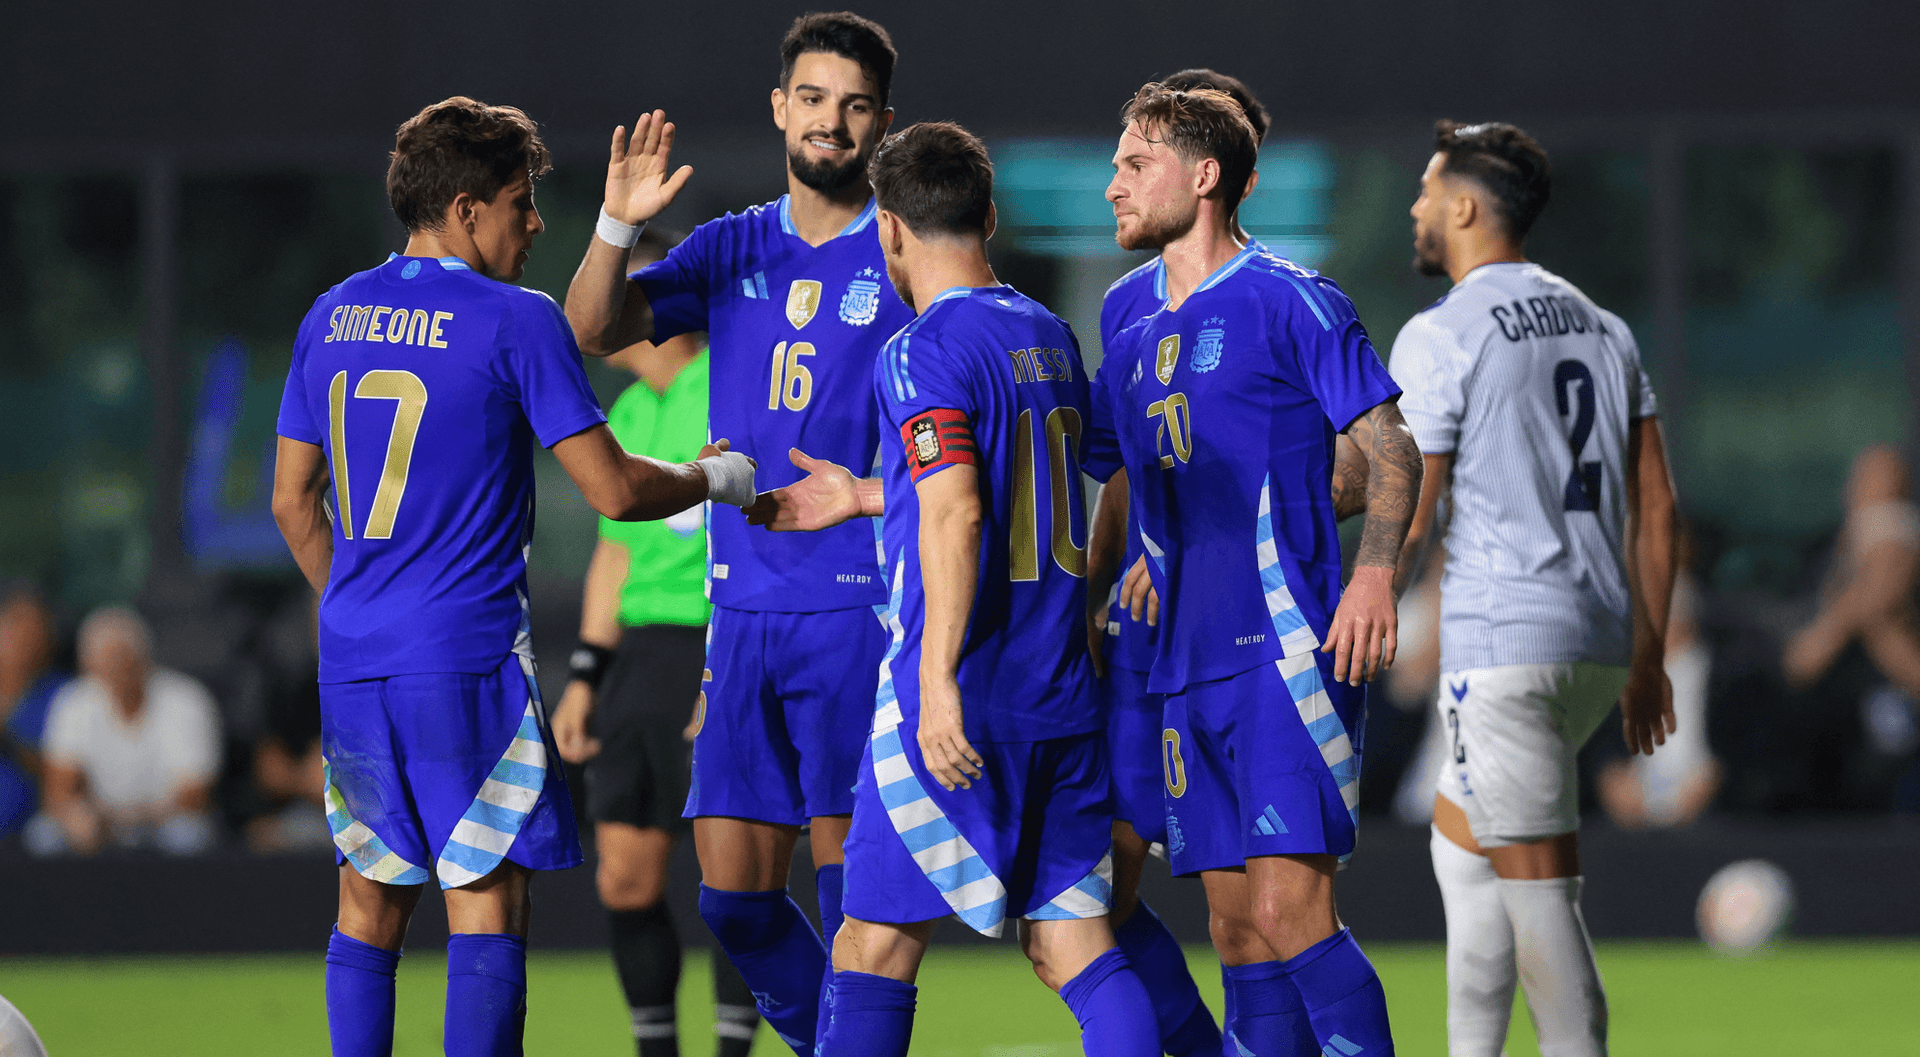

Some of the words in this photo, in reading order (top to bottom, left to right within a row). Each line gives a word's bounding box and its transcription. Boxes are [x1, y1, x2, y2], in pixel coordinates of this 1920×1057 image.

[324, 305, 454, 349] SIMEONE
[1491, 295, 1609, 342] CARDO
[768, 340, 817, 412] 16
[1007, 347, 1073, 383] MESSI
[328, 369, 428, 540] 17
[1146, 392, 1192, 470] 20
[1552, 358, 1602, 512] 2
[1010, 406, 1089, 582] 10
[1448, 708, 1466, 764] 2
